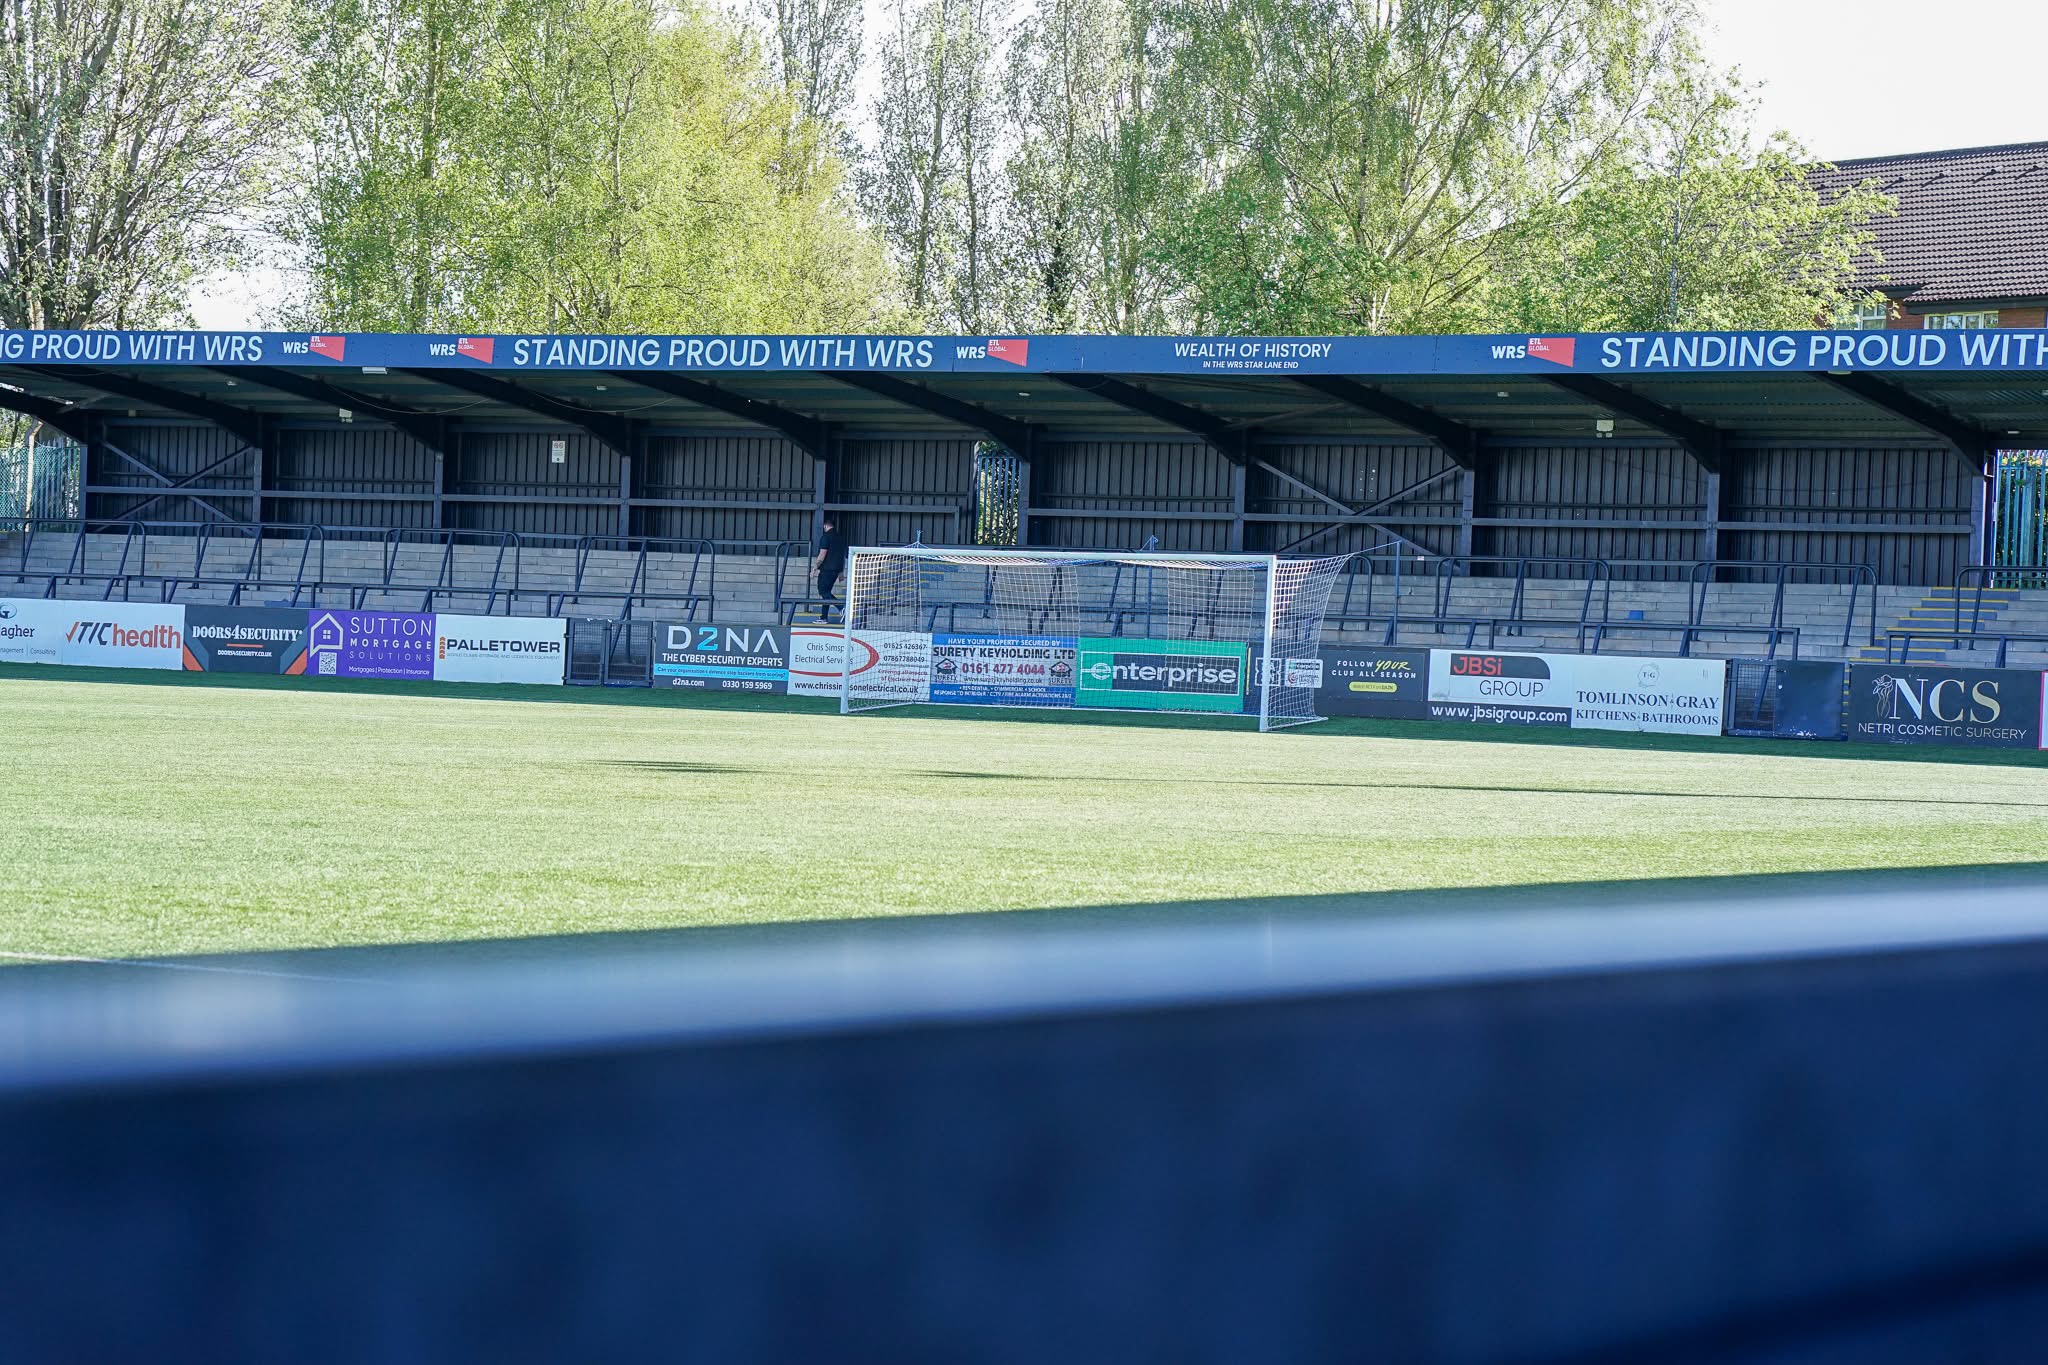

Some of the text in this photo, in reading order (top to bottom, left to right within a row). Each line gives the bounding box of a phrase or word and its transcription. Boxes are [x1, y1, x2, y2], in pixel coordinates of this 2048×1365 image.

[32, 333, 121, 360] PROUD
[130, 334, 194, 361] WITH
[204, 335, 263, 362] WRS
[282, 341, 309, 354] WRS
[1529, 337, 1542, 345] ETL
[429, 343, 456, 356] WRS
[513, 338, 933, 367] STANDING PROUD WITH WRS
[956, 346, 986, 360] WRS
[1174, 343, 1332, 358] WEALTH OF HISTORY
[1491, 345, 1526, 359] WRS
[1600, 335, 1797, 368] STANDING
[1808, 335, 1948, 367] PROUD
[1202, 360, 1211, 368] IN
[1264, 361, 1282, 369] LANE
[1283, 361, 1299, 369] END
[192, 624, 299, 642] DOORS4SECURITY
[350, 616, 432, 637] SUTTON
[350, 638, 432, 650] MORTGAGE
[446, 638, 560, 653] PALLETOWER
[667, 625, 780, 654] D2NA
[986, 638, 1020, 646] PROPERTY
[806, 642, 824, 652] Chris
[933, 646, 1076, 660] SURETY KEYHOLDING LTD
[349, 650, 431, 662] SOLUTIONS
[662, 652, 783, 667] THE CYBER SECURITY EXPERTS
[794, 654, 854, 665] Electrical Servis
[348, 666, 375, 674] Mortgages
[377, 666, 403, 675] Protection
[962, 662, 1046, 676] 0161 477 4044
[1336, 659, 1412, 672] FOLLOW YOUR
[1454, 656, 1502, 676] JBSi
[1090, 662, 1237, 687] enterprise
[672, 678, 705, 687] d2na.com
[722, 680, 773, 690] 0330 159 5969
[1479, 679, 1544, 698] GROUP
[1576, 690, 1720, 710] TOMLINSON GRAY
[1889, 677, 2001, 724] NCS
[1432, 706, 1568, 724] www.jbsigroup.com
[1576, 709, 1719, 726] KITCHENS BATHROOMS
[1858, 722, 2027, 740] NETRI COSMETIC SURGERY
